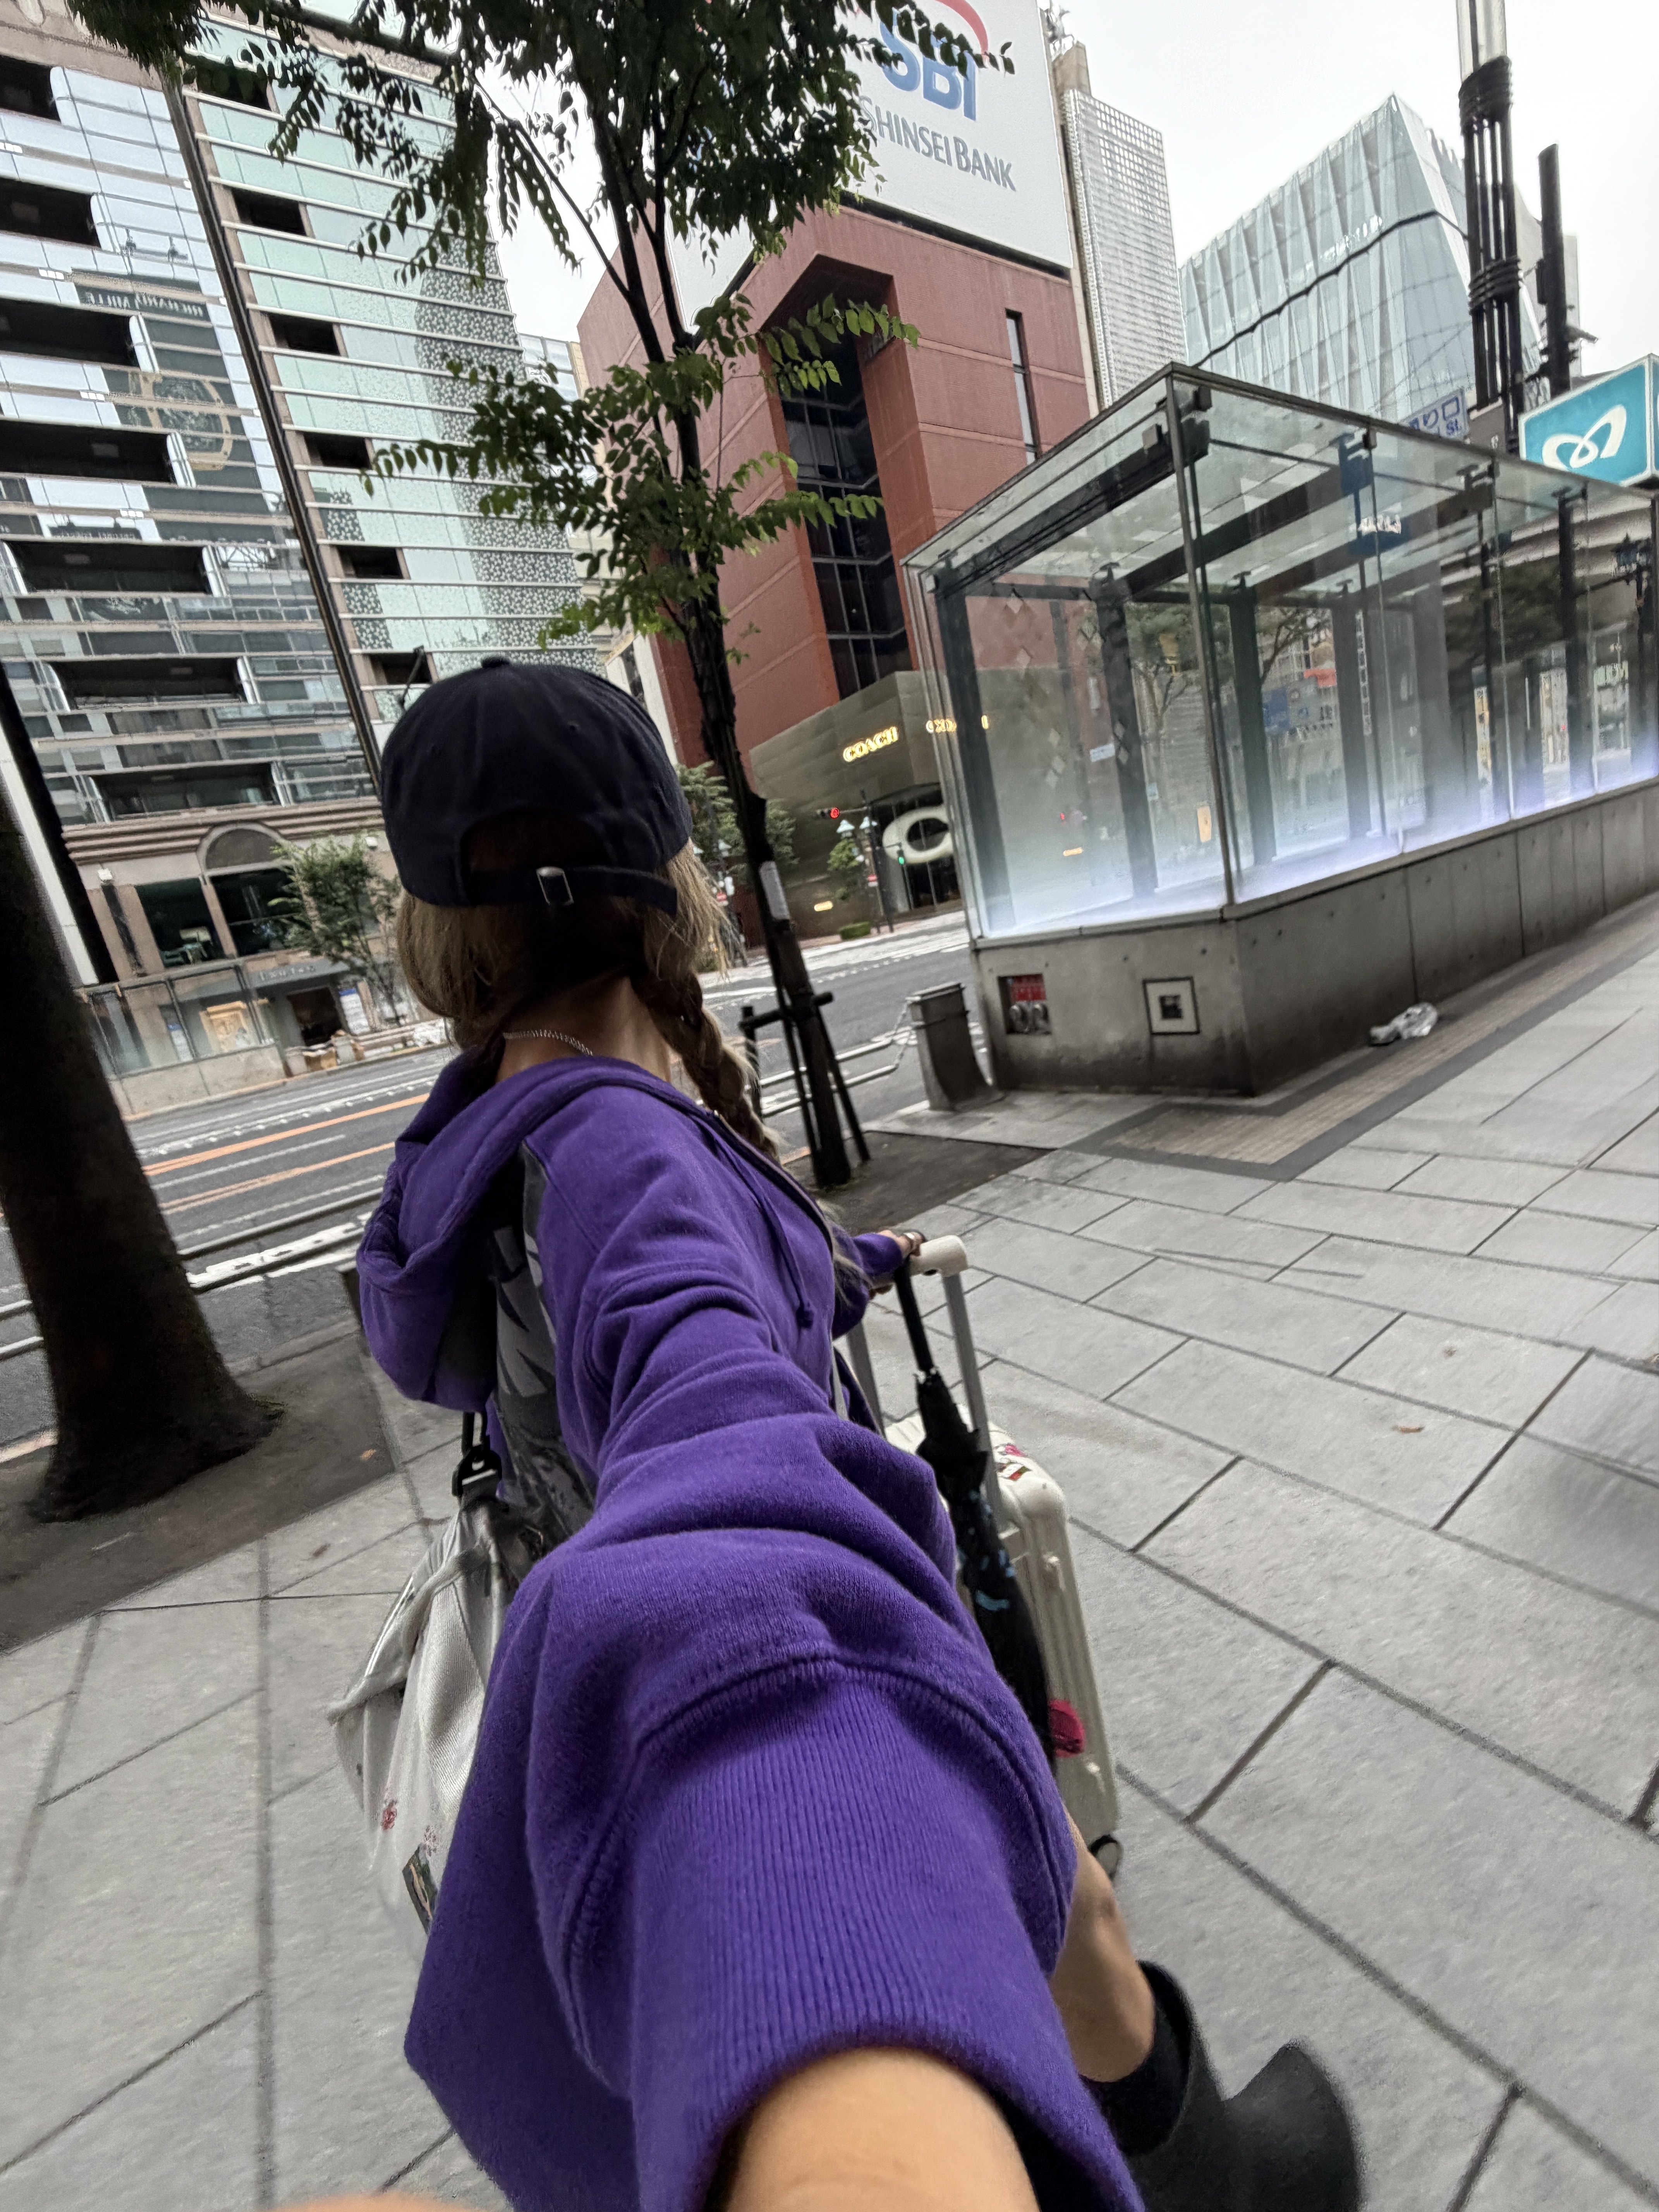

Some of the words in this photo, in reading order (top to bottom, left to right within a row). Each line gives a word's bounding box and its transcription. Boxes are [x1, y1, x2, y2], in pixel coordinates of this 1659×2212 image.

[860, 95, 952, 167] SHINSEI
[953, 136, 1016, 192] BANK
[843, 726, 899, 763] COACH
